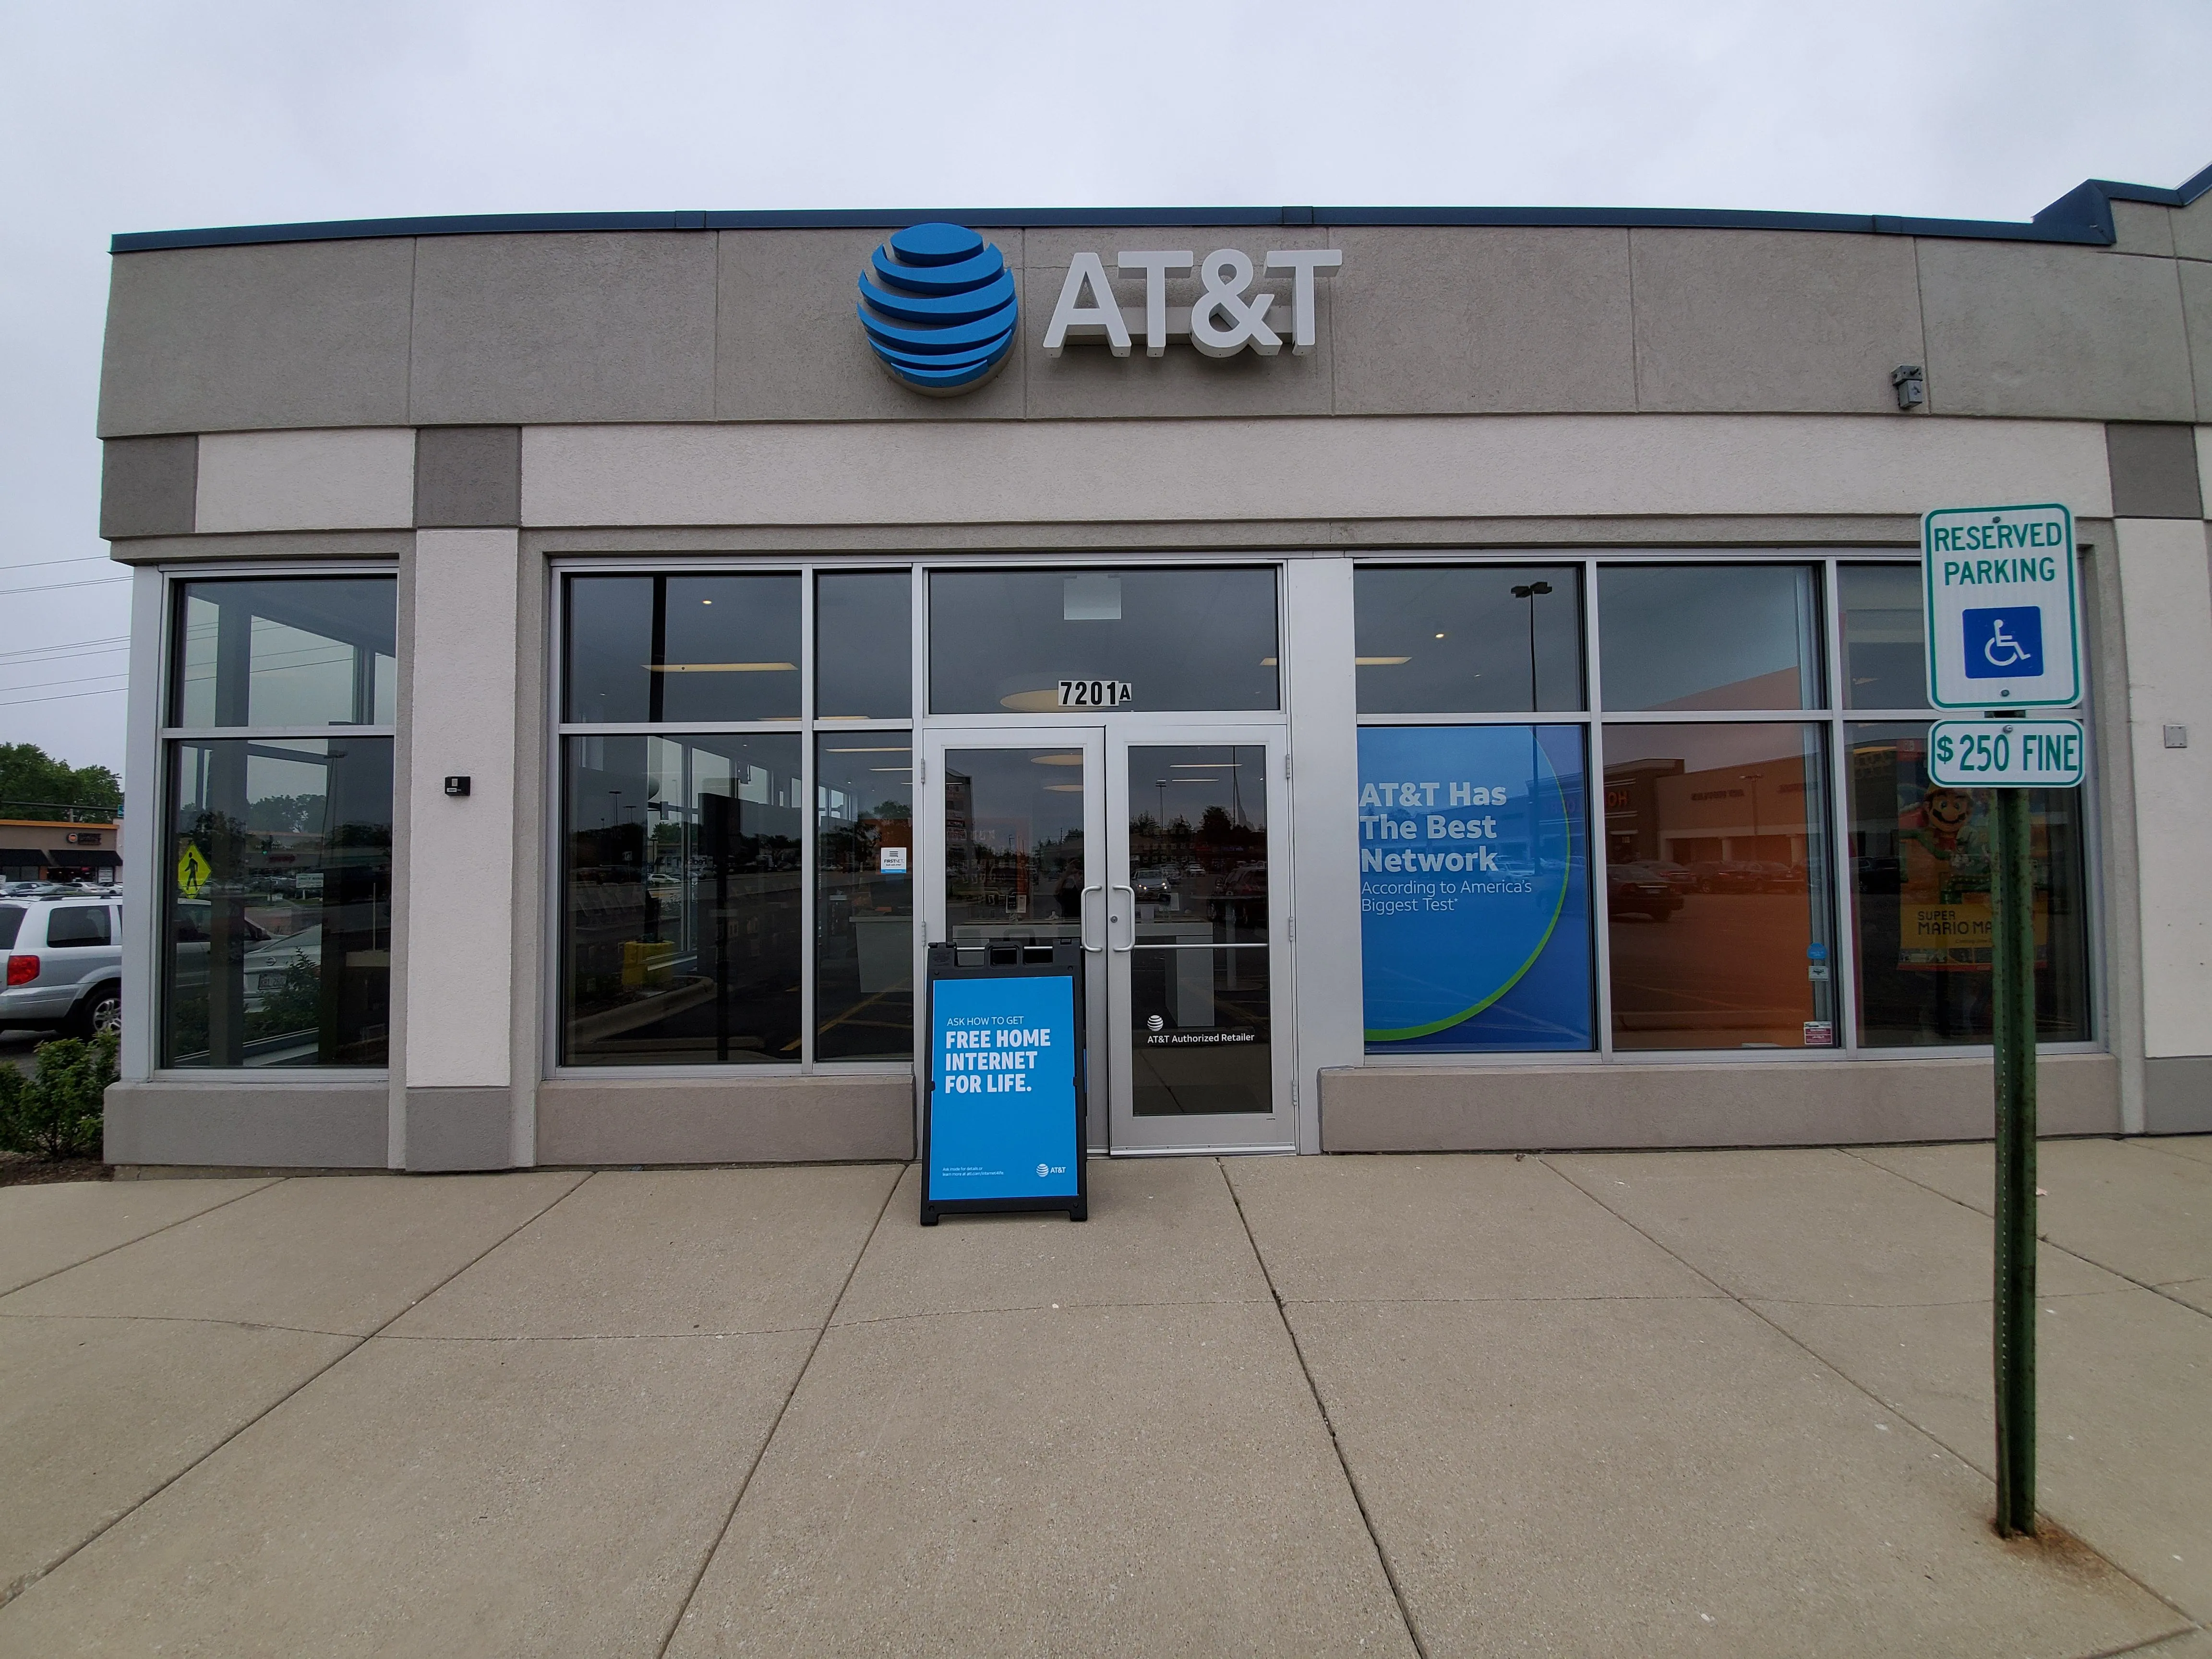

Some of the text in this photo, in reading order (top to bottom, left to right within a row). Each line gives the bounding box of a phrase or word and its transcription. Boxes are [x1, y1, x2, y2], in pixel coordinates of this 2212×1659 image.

[1043, 249, 1342, 357] AT&T
[1934, 522, 2061, 552] RESERVED
[1945, 557, 2055, 586] PARKING
[1936, 734, 2078, 771] $250 FINE
[1359, 782, 1507, 806] AT&T Has
[1359, 814, 1497, 840] The Best
[1361, 846, 1498, 872] Network
[1361, 881, 1435, 896] According
[1440, 882, 1456, 894] to
[1362, 898, 1419, 915] Biggest
[1918, 910, 1956, 921] SUPER
[1918, 921, 1969, 935] MARIO
[946, 1016, 1024, 1026] ASK HOW TO GET
[946, 1029, 1050, 1049] FREE HOME
[1147, 1033, 1255, 1043] AT&T Authorized Retailer
[945, 1051, 1037, 1071] INTERNET
[945, 1073, 1032, 1094] FOR LIFE.
